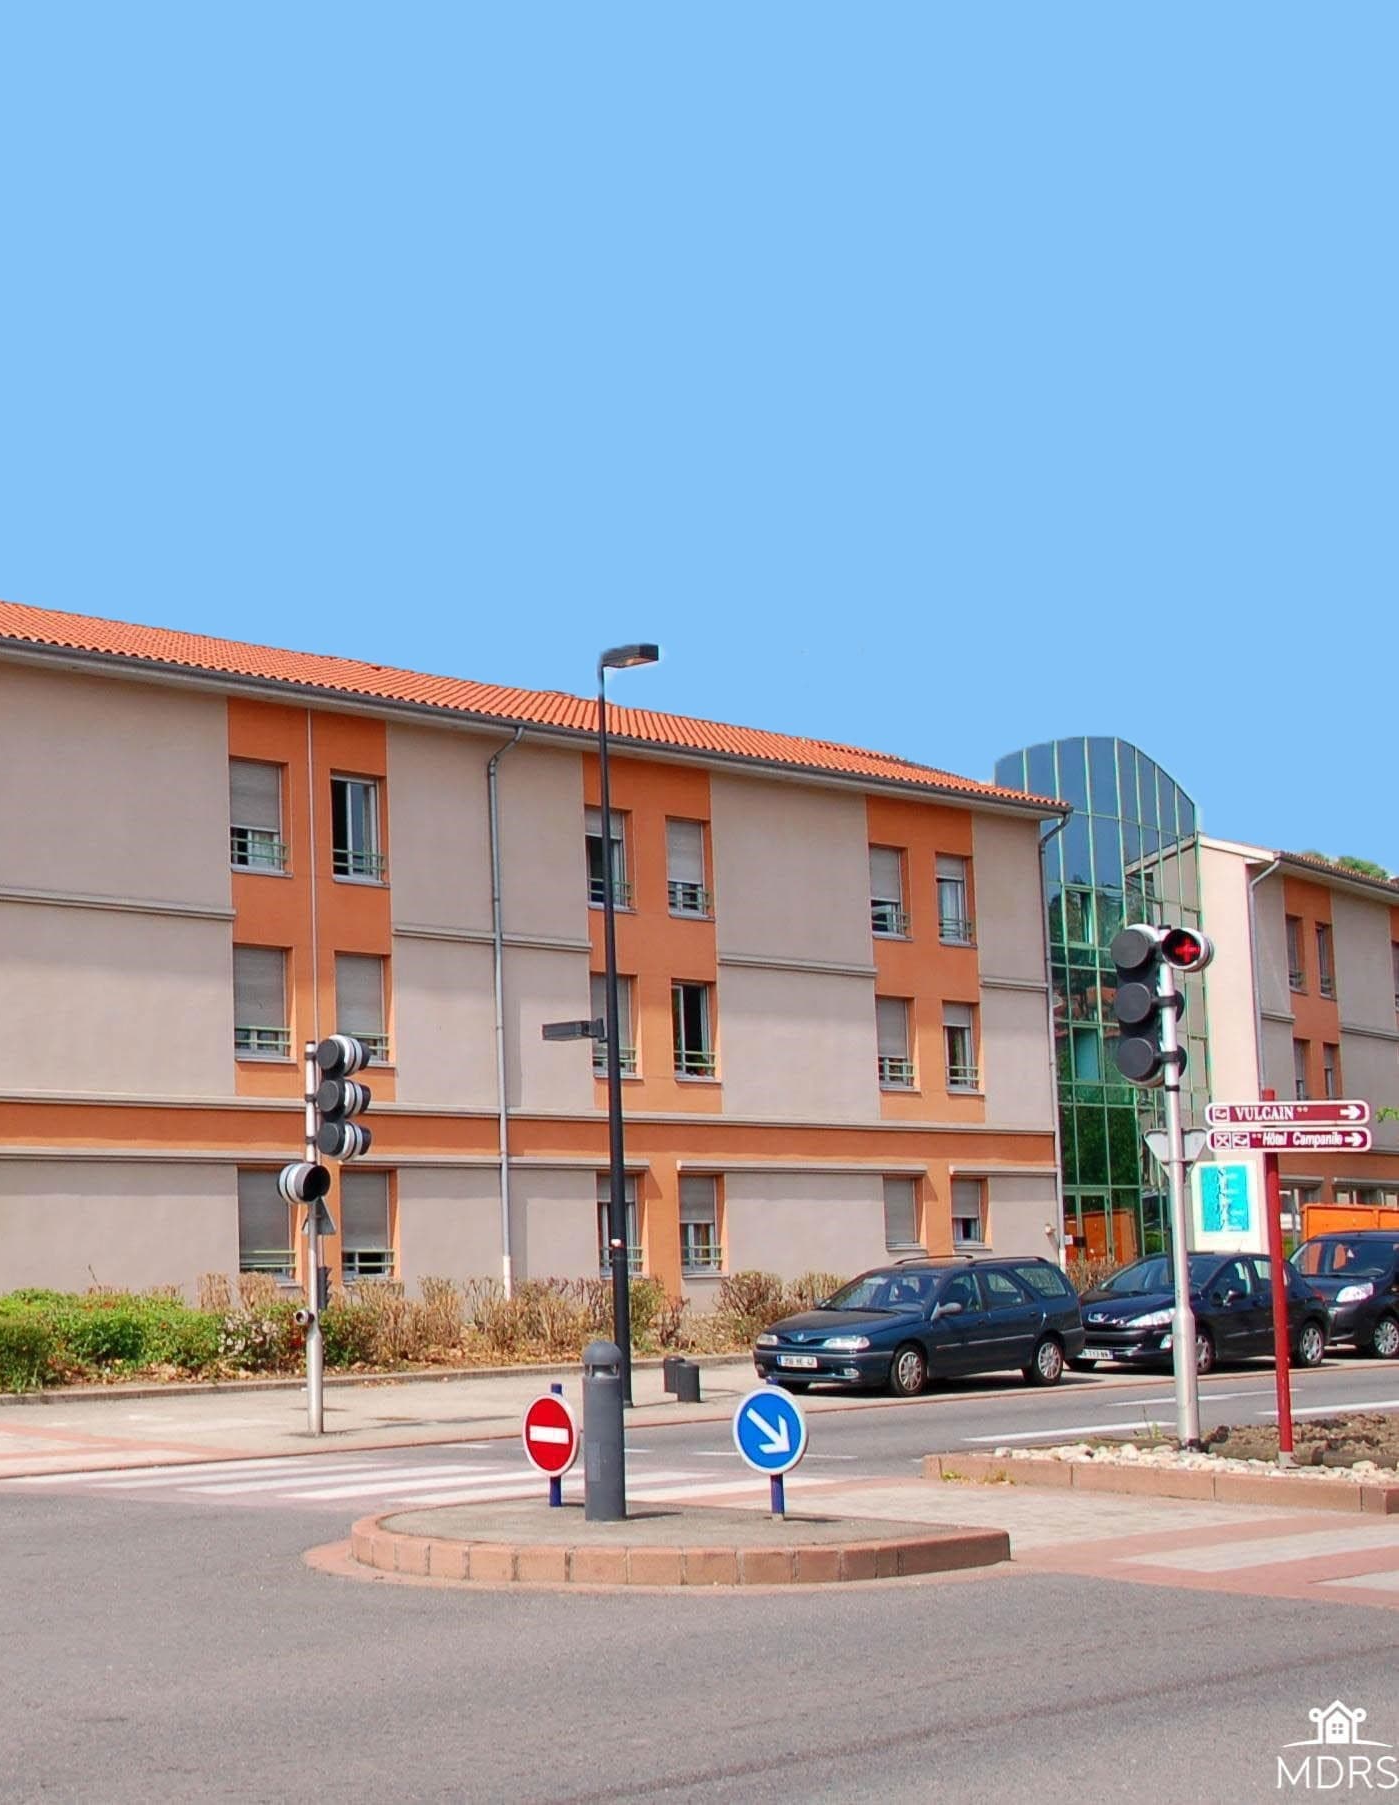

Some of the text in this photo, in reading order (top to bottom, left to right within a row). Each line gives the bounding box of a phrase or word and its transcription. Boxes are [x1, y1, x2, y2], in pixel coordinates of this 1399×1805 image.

[1235, 1106, 1294, 1121] VULCAIN
[1262, 1131, 1343, 1148] Hôtel Campanile
